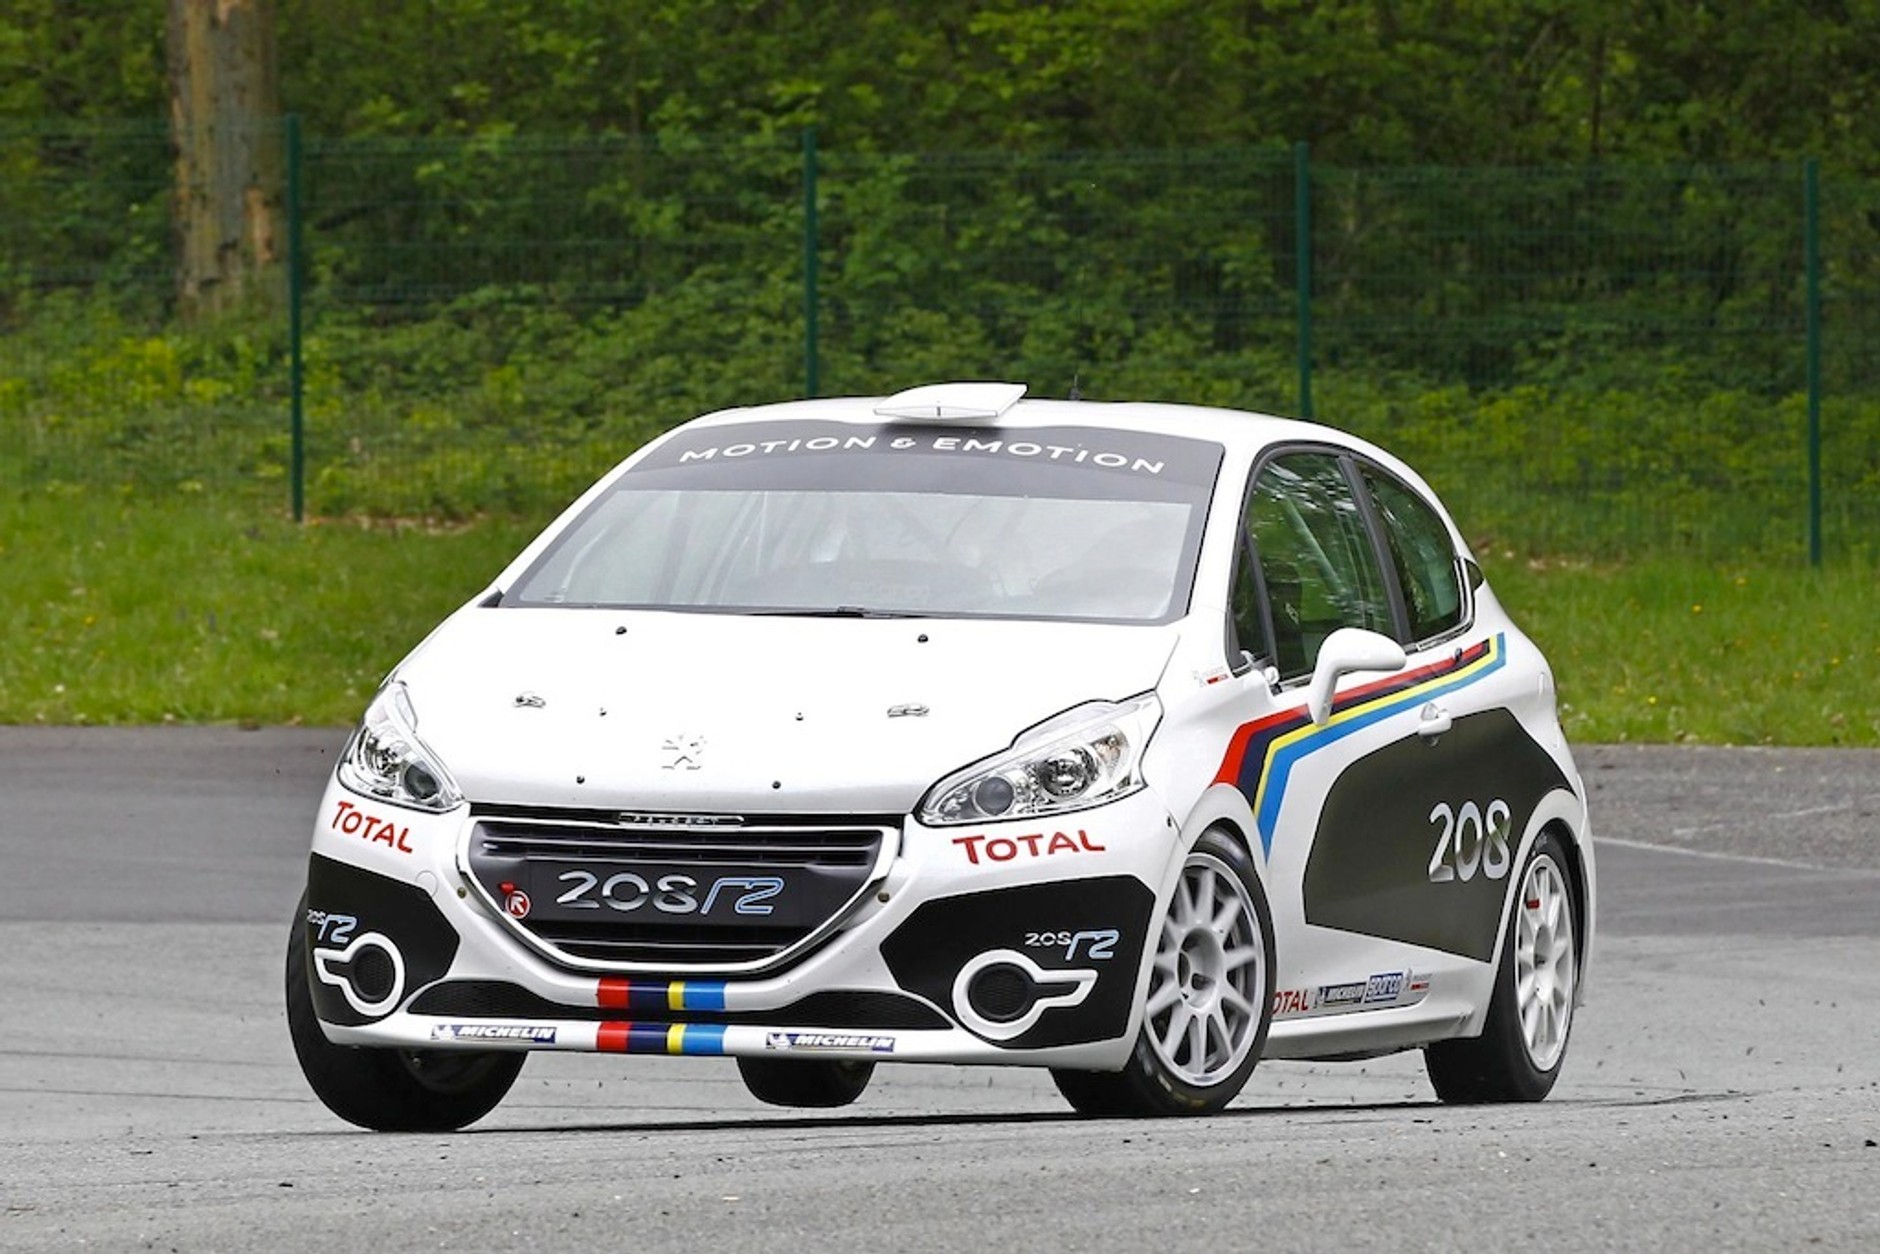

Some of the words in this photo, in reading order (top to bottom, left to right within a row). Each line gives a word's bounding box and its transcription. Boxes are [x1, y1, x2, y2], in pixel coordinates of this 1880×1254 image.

[678, 436, 877, 463] MOTION
[890, 436, 916, 450] &
[932, 437, 1165, 475] EMOTION
[331, 801, 414, 854] TOTAL
[1428, 799, 1511, 883] 208
[951, 829, 1106, 866] TOTAL
[1272, 989, 1308, 1015] OTAL
[458, 1025, 555, 1040] MICHELIN
[794, 1034, 893, 1049] MICHELIN
